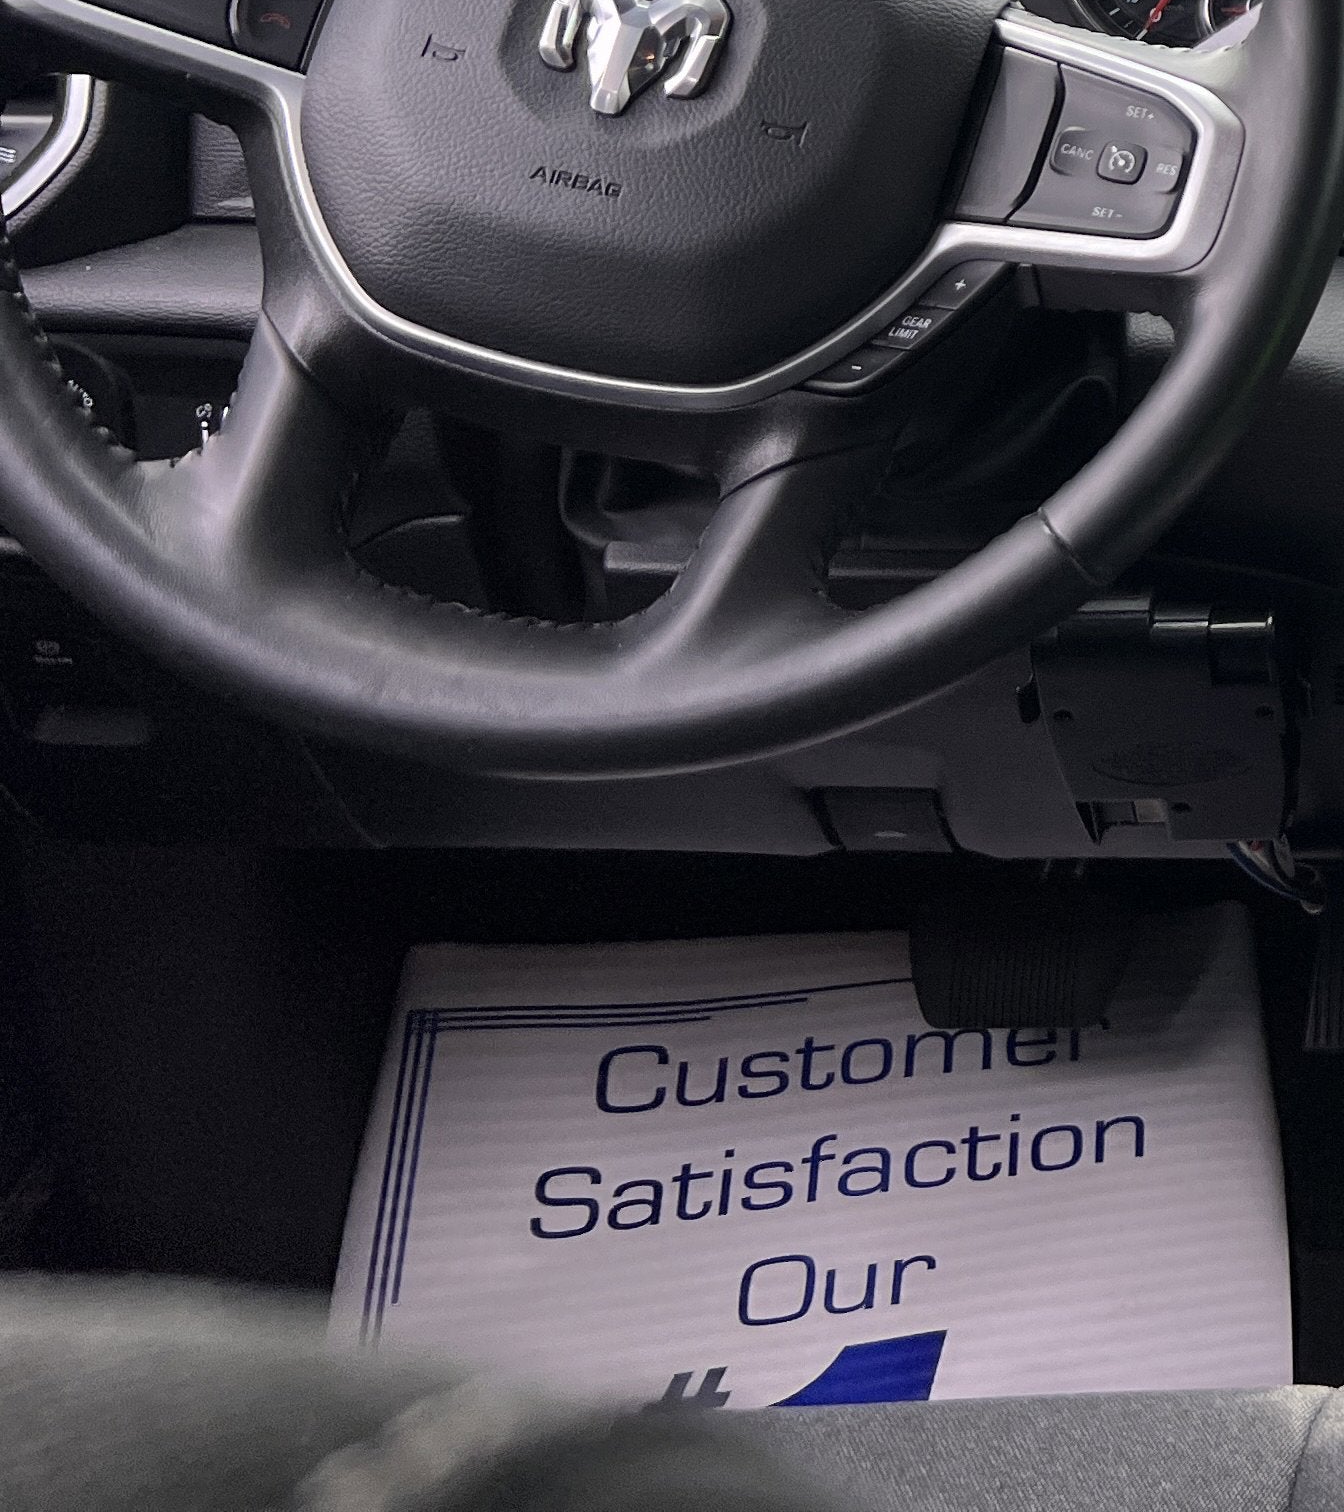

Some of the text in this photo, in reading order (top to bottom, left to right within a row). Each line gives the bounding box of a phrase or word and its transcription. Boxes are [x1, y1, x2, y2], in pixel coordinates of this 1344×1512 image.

[1060, 142, 1095, 161] CANC
[529, 164, 623, 198] AIRBAG
[1155, 161, 1177, 177] RES
[887, 327, 919, 340] LIMIT
[901, 315, 932, 329] GEAR
[596, 1025, 1112, 1115] Customer
[529, 1112, 1147, 1240] Satisfaction
[737, 1254, 937, 1329] Our
